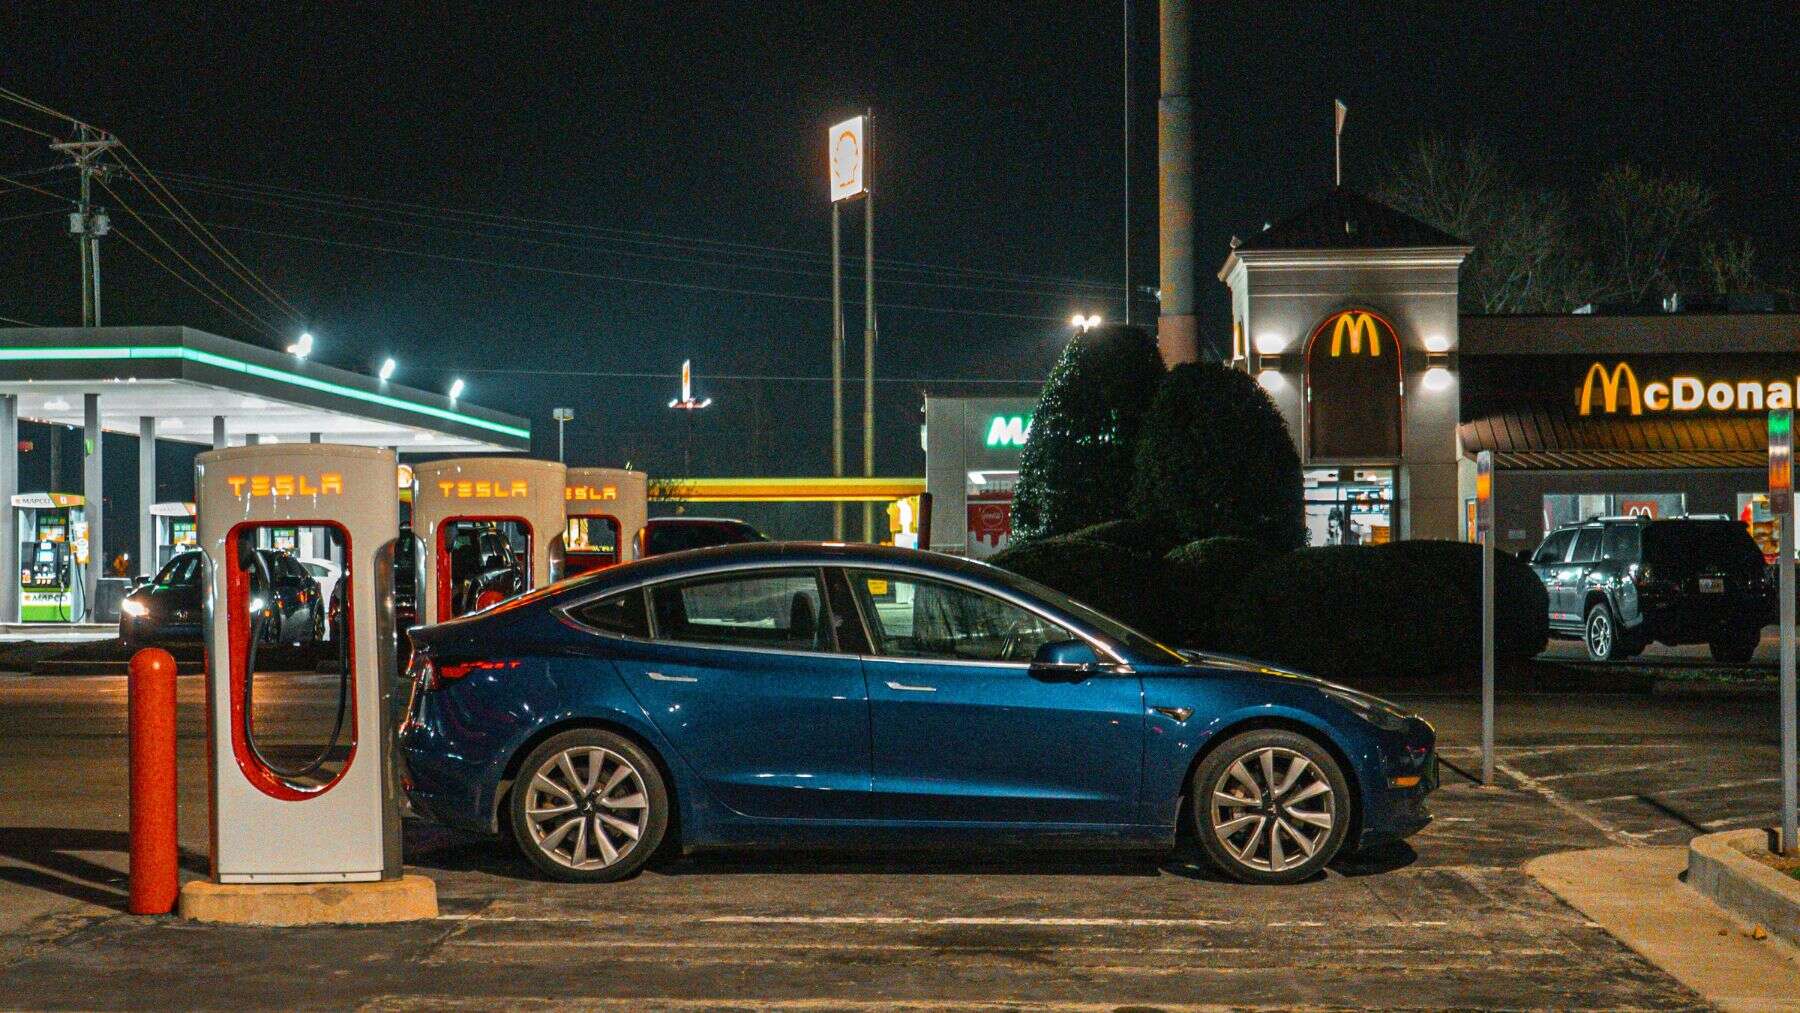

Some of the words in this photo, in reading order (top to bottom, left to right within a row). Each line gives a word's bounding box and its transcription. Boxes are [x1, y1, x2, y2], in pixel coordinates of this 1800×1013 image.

[227, 474, 343, 497] TESLA
[438, 480, 528, 498] TESLA
[565, 486, 617, 500] ESLA
